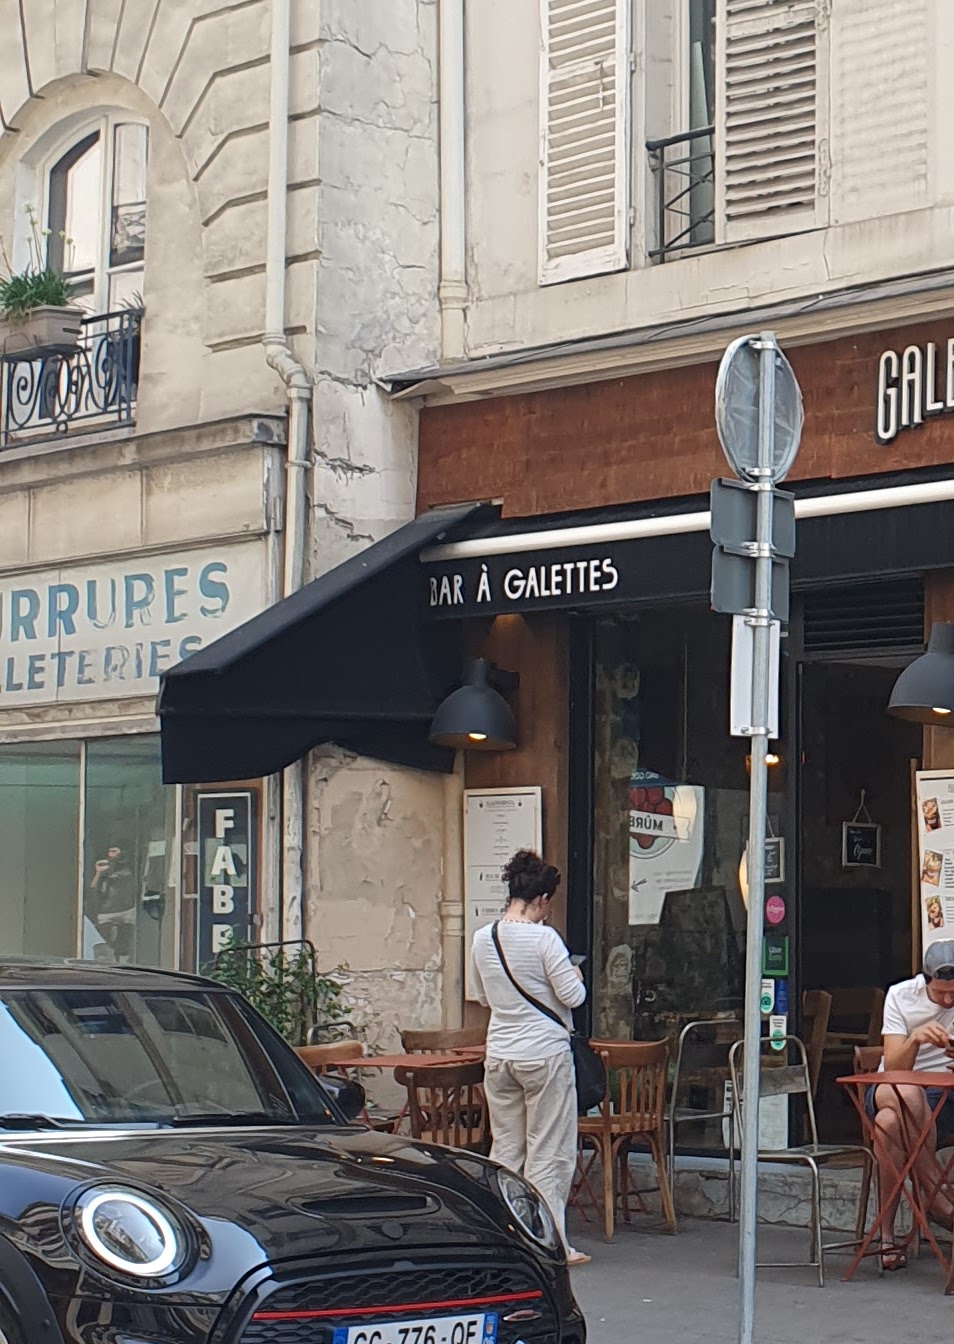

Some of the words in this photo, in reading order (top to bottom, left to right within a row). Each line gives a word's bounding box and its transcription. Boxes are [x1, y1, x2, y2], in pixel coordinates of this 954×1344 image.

[0, 562, 230, 643] RRURES
[429, 574, 464, 606] BAR
[476, 564, 491, 602] À
[504, 558, 618, 599] GALETTES
